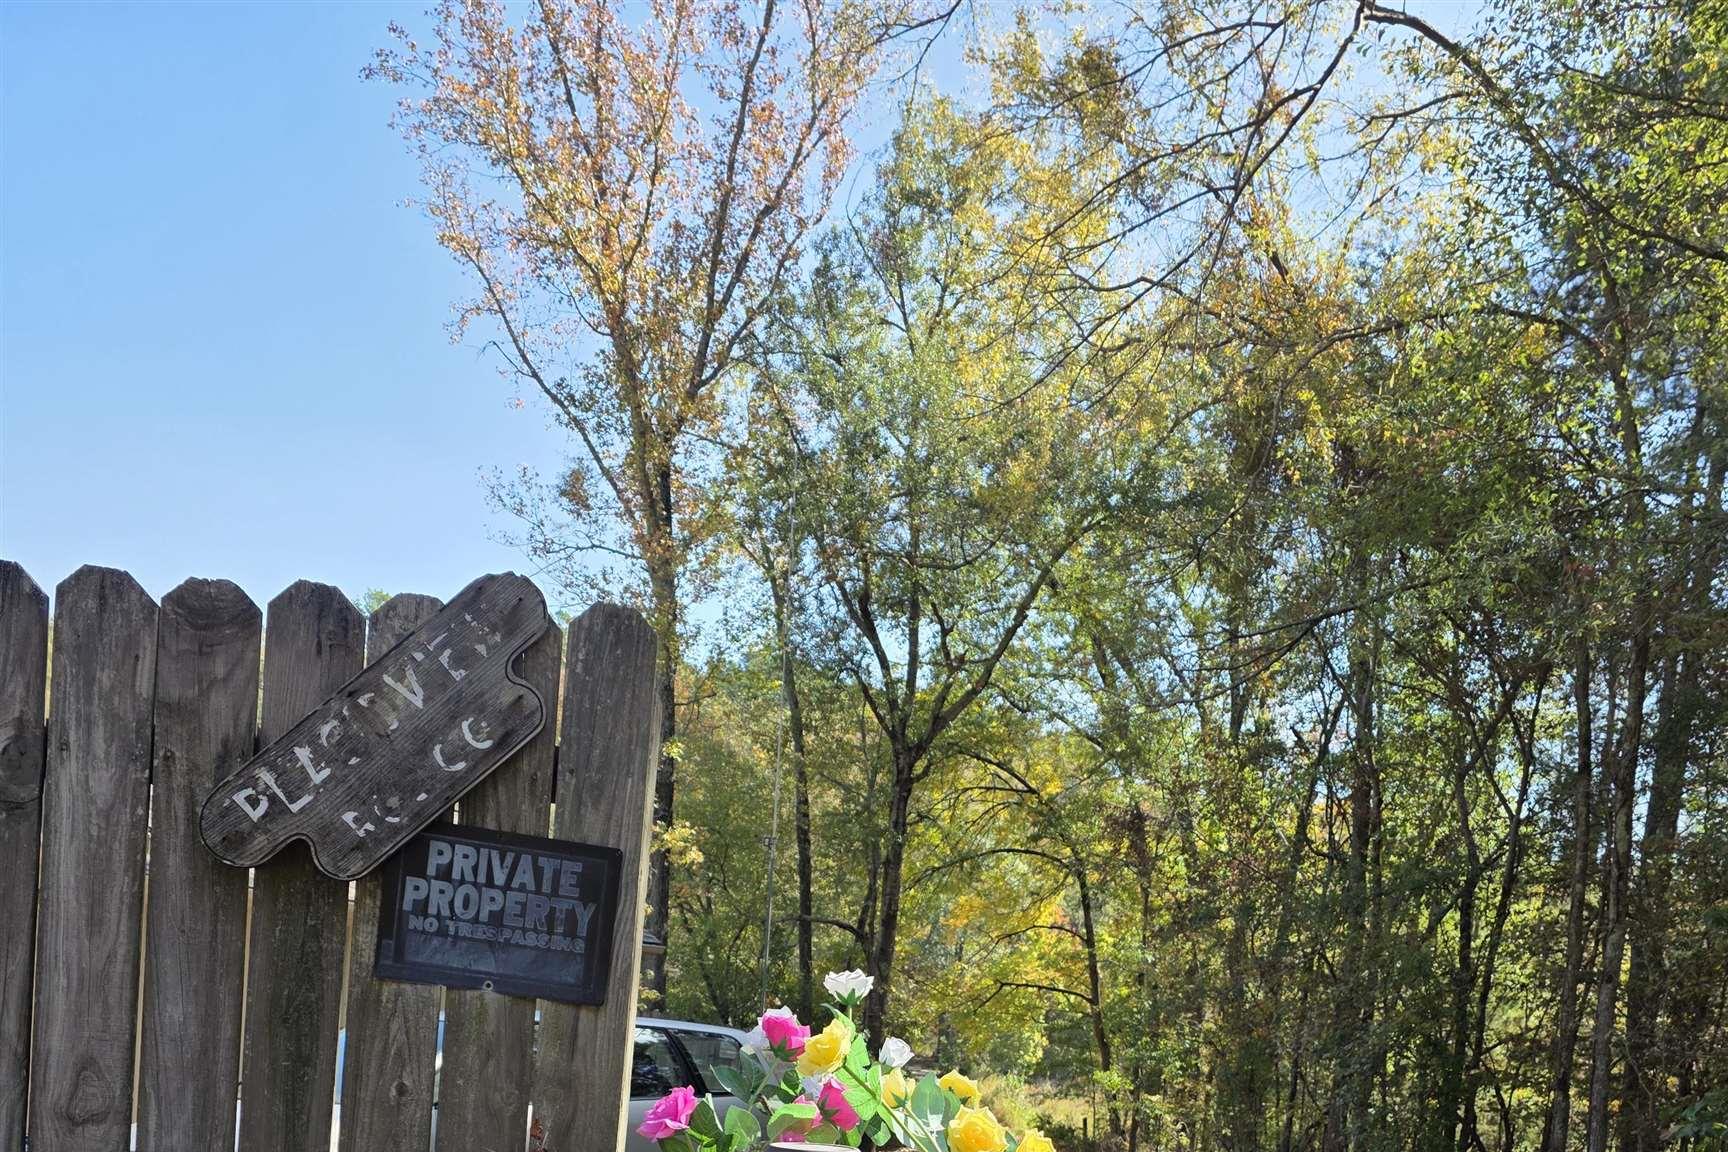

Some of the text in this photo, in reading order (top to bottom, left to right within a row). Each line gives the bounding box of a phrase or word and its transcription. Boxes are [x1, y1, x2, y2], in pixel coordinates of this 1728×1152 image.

[426, 840, 583, 897] PRIVATE
[402, 876, 598, 937] PROPERTY
[408, 914, 585, 953] NO TRESPASSING
